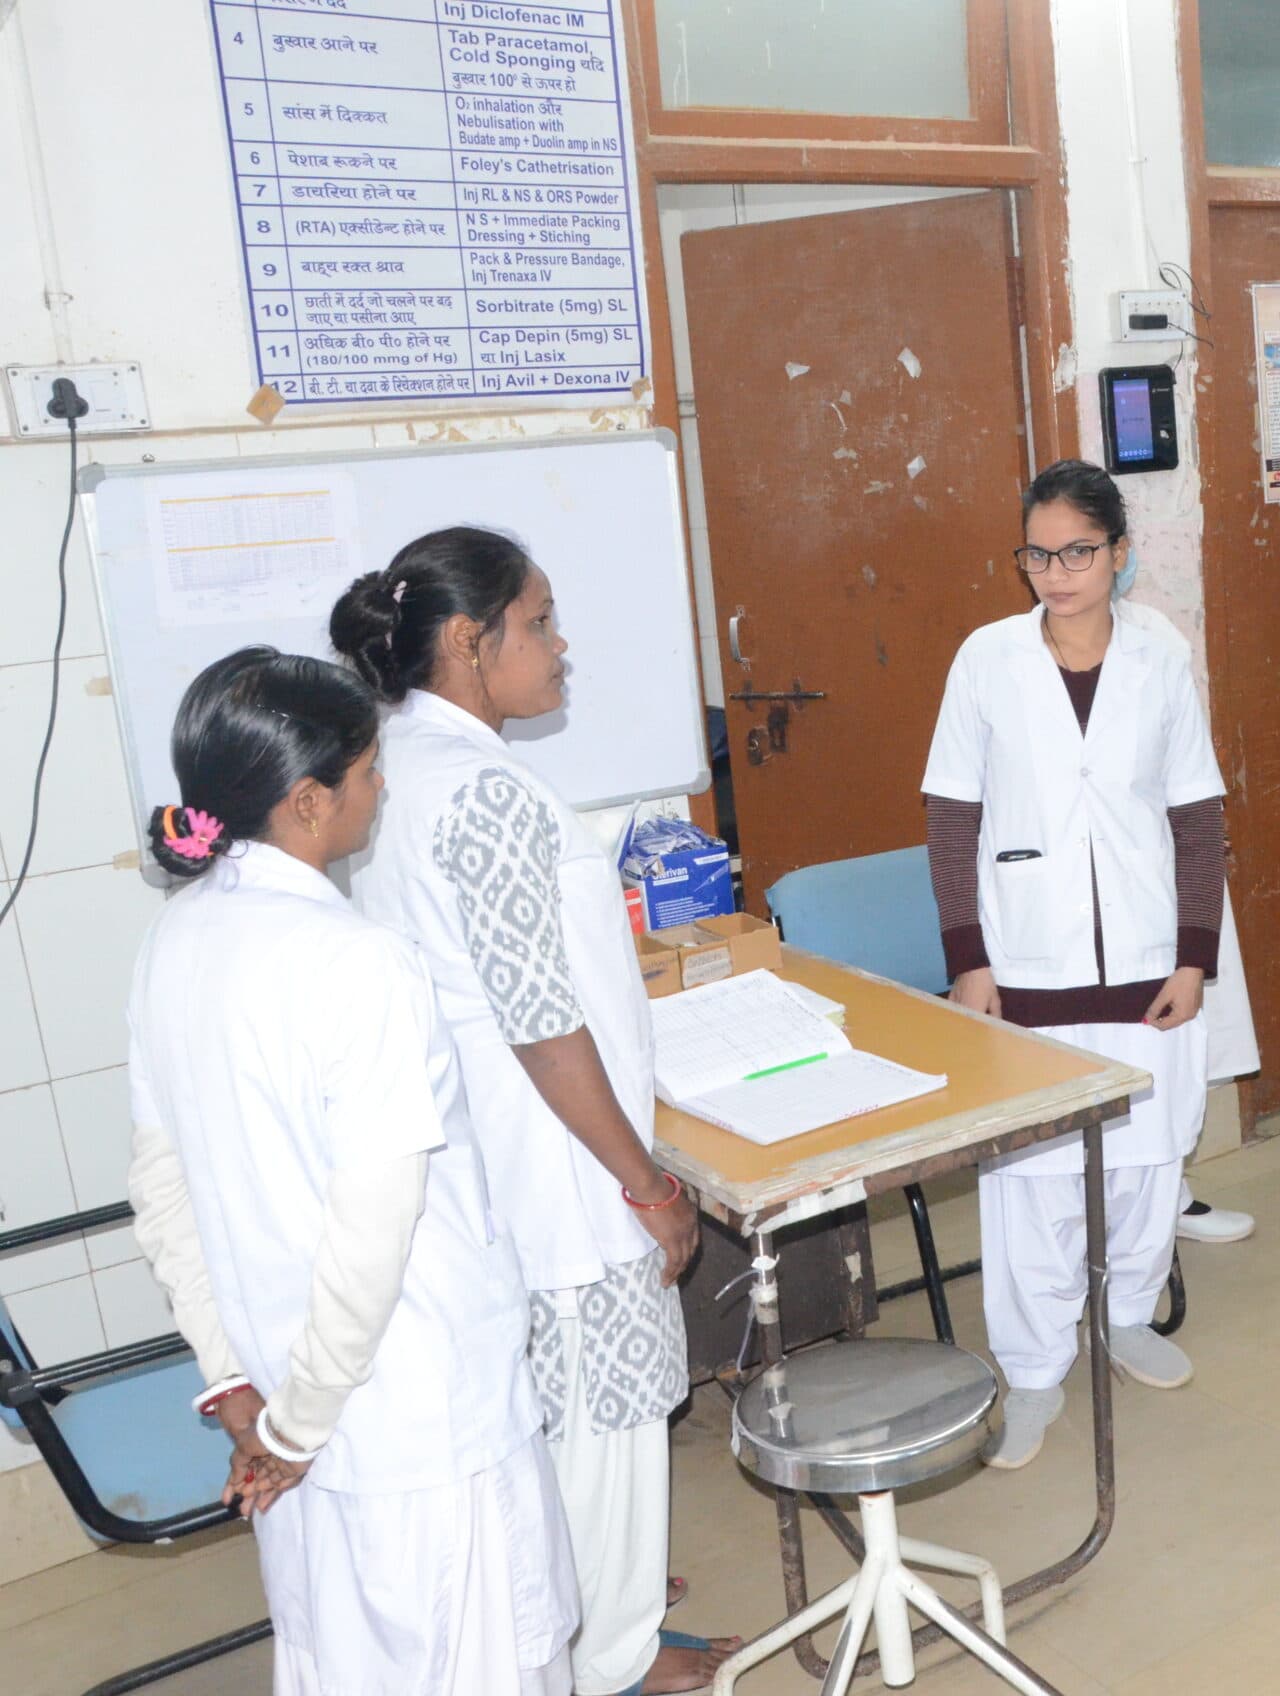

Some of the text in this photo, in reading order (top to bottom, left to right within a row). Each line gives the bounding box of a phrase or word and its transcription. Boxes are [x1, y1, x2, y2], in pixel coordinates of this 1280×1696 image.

[444, 2, 585, 27] Inj Diclofenac IM
[232, 31, 244, 45] 4
[271, 34, 379, 54] बुखार आने पर
[448, 29, 594, 56] Tab Paracetamol,
[450, 47, 605, 73] Cold Sponging यदि
[452, 72, 486, 89] बुखार
[521, 73, 533, 88] से
[535, 77, 564, 91] ऊपर
[565, 76, 576, 92] हो
[244, 103, 254, 116] 5
[281, 104, 388, 124] सांस में दिक्कत
[473, 97, 534, 114] inhalation
[538, 98, 563, 115] और
[457, 114, 565, 132] Nebulisation with
[459, 131, 496, 146] Budate
[499, 136, 520, 150] amp
[533, 135, 565, 149] Duolin
[568, 138, 589, 152] amp
[591, 138, 600, 150] in
[602, 138, 617, 151] NS
[250, 151, 261, 165] 6
[287, 150, 329, 168] पेशाब
[378, 157, 398, 170] पर
[461, 156, 615, 176] Foley's Cathetrisation
[253, 184, 266, 198] 7
[291, 182, 417, 201] डायरिया होने पर
[463, 187, 619, 205] Inj RL & NS & ORS Powder
[256, 220, 271, 233] 8
[296, 220, 336, 237] (RTA)
[402, 218, 426, 236] होने
[428, 223, 447, 237] पर
[504, 214, 568, 227] Immediate
[572, 215, 620, 231] Packing
[468, 229, 525, 245] Dressing
[540, 230, 590, 246] Stiching
[341, 261, 372, 273] रक्त
[470, 252, 625, 268] Pack & Pressure Bandage,
[262, 264, 277, 277] 9
[472, 269, 552, 285] Inj Trenaxa IV
[304, 292, 333, 309] छाती
[335, 294, 346, 309] में
[349, 292, 364, 310] दर्द
[368, 293, 384, 309] जो
[386, 292, 417, 308] चलने
[418, 295, 435, 308] पर
[476, 299, 628, 315] Sorbitrate (5mg) SL
[260, 304, 289, 317] 10
[306, 308, 417, 327] जाए या पसीना आए
[304, 334, 348, 351] अधिक
[406, 331, 430, 349] होने
[434, 335, 451, 348] पर
[479, 328, 633, 346] Cap Depin (5mg) SL
[266, 345, 290, 359] 11
[306, 352, 458, 367] (180/100 mmg of Hg)
[480, 350, 566, 366] या Inj Lasix
[360, 380, 377, 393] दवा
[379, 376, 391, 392] के
[436, 374, 455, 392] होने
[457, 377, 470, 390] पर
[482, 375, 501, 390] Inj
[505, 374, 535, 387] Avil
[554, 372, 611, 386] Dexona
[616, 370, 630, 384] IV
